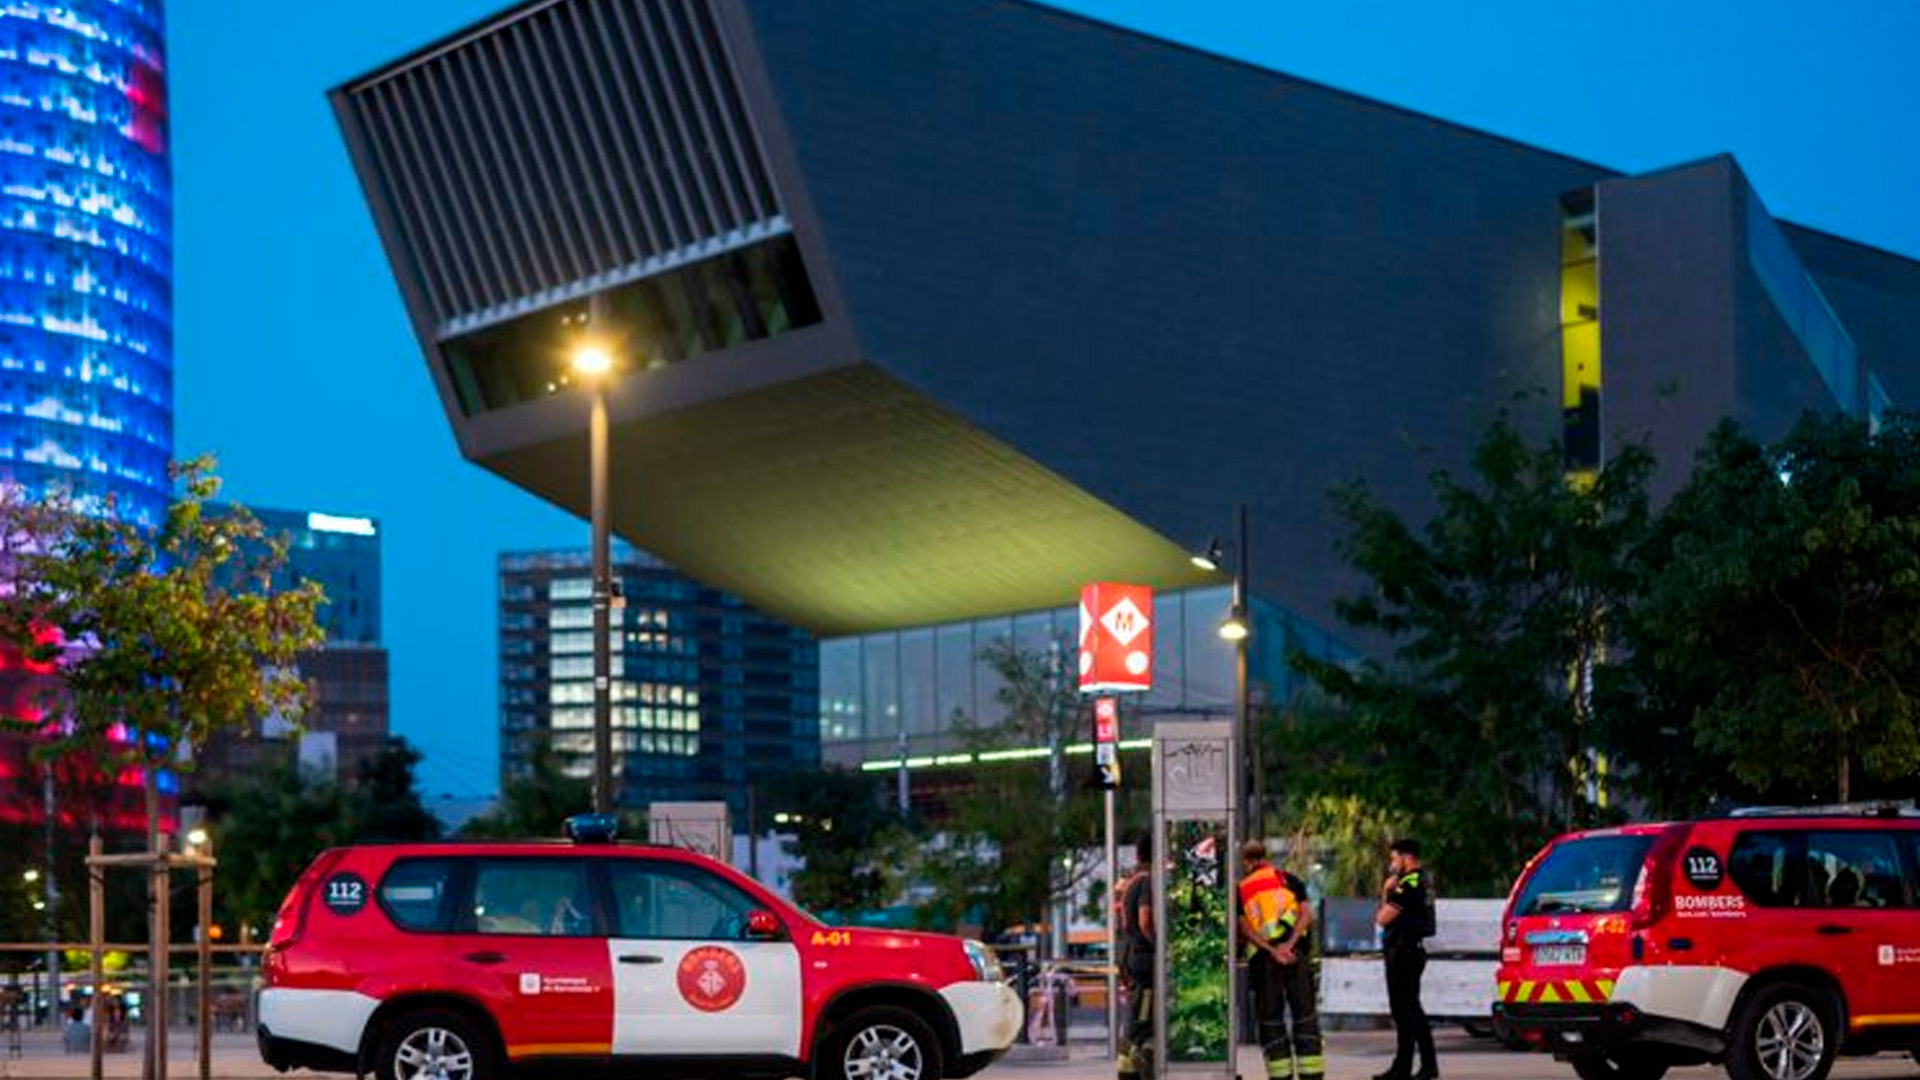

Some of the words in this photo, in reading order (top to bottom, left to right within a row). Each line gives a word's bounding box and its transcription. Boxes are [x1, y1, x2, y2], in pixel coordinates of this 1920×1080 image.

[1114, 610, 1134, 632] M
[1688, 856, 1719, 874] 112
[329, 881, 362, 898] 112
[1675, 895, 1745, 910] BOMBERS
[810, 930, 851, 947] A-01
